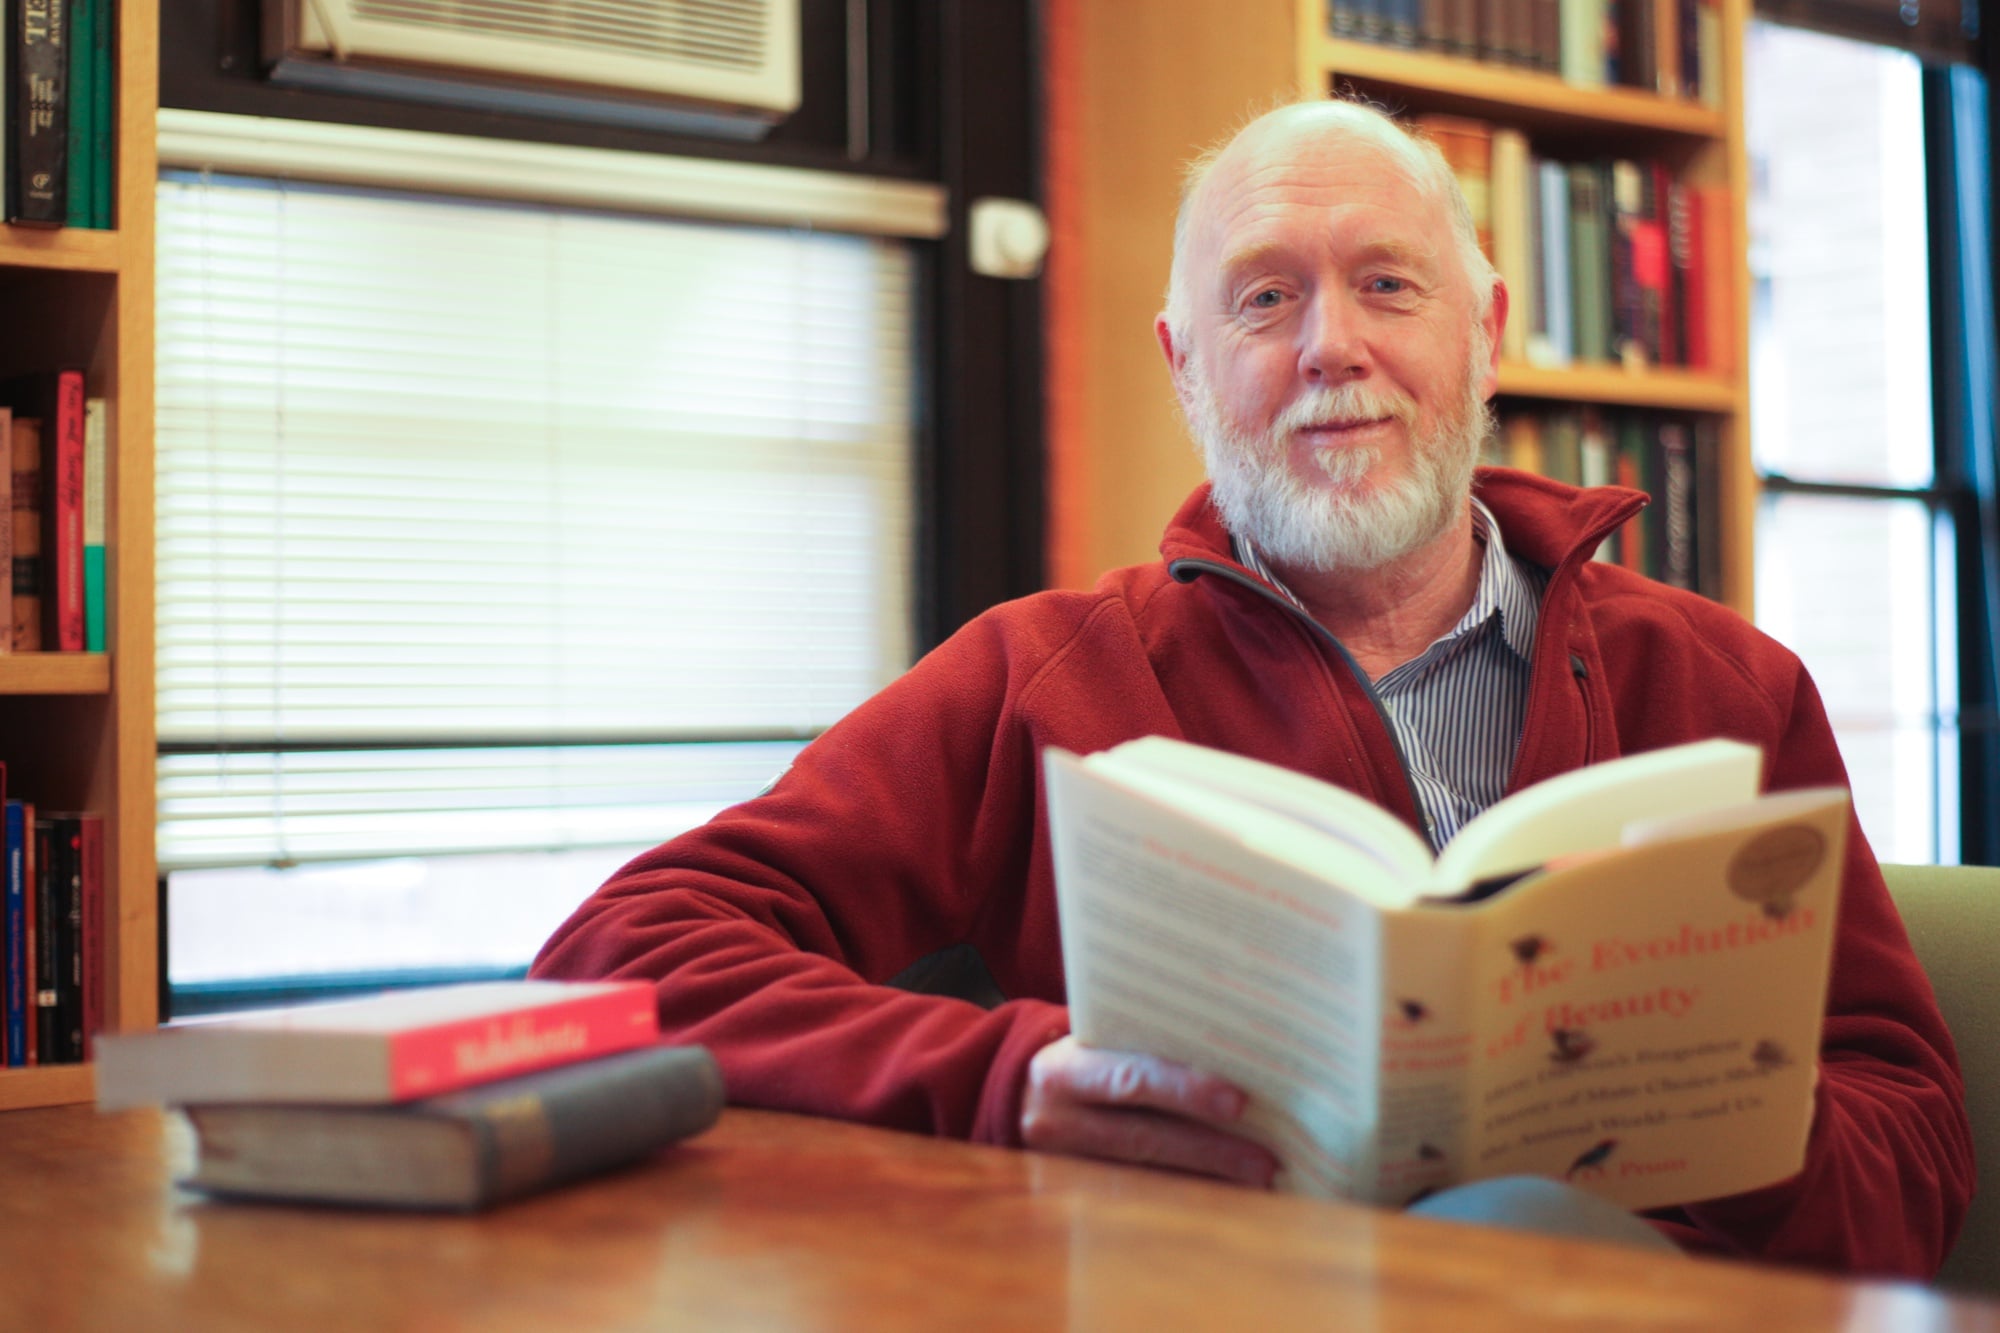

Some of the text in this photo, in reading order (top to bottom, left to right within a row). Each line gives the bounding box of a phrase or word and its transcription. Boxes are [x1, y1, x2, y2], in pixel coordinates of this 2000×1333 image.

[1491, 908, 1816, 1005] The Evolution
[1486, 986, 1702, 1058] of Beauty
[1618, 1159, 1689, 1180] Prum
